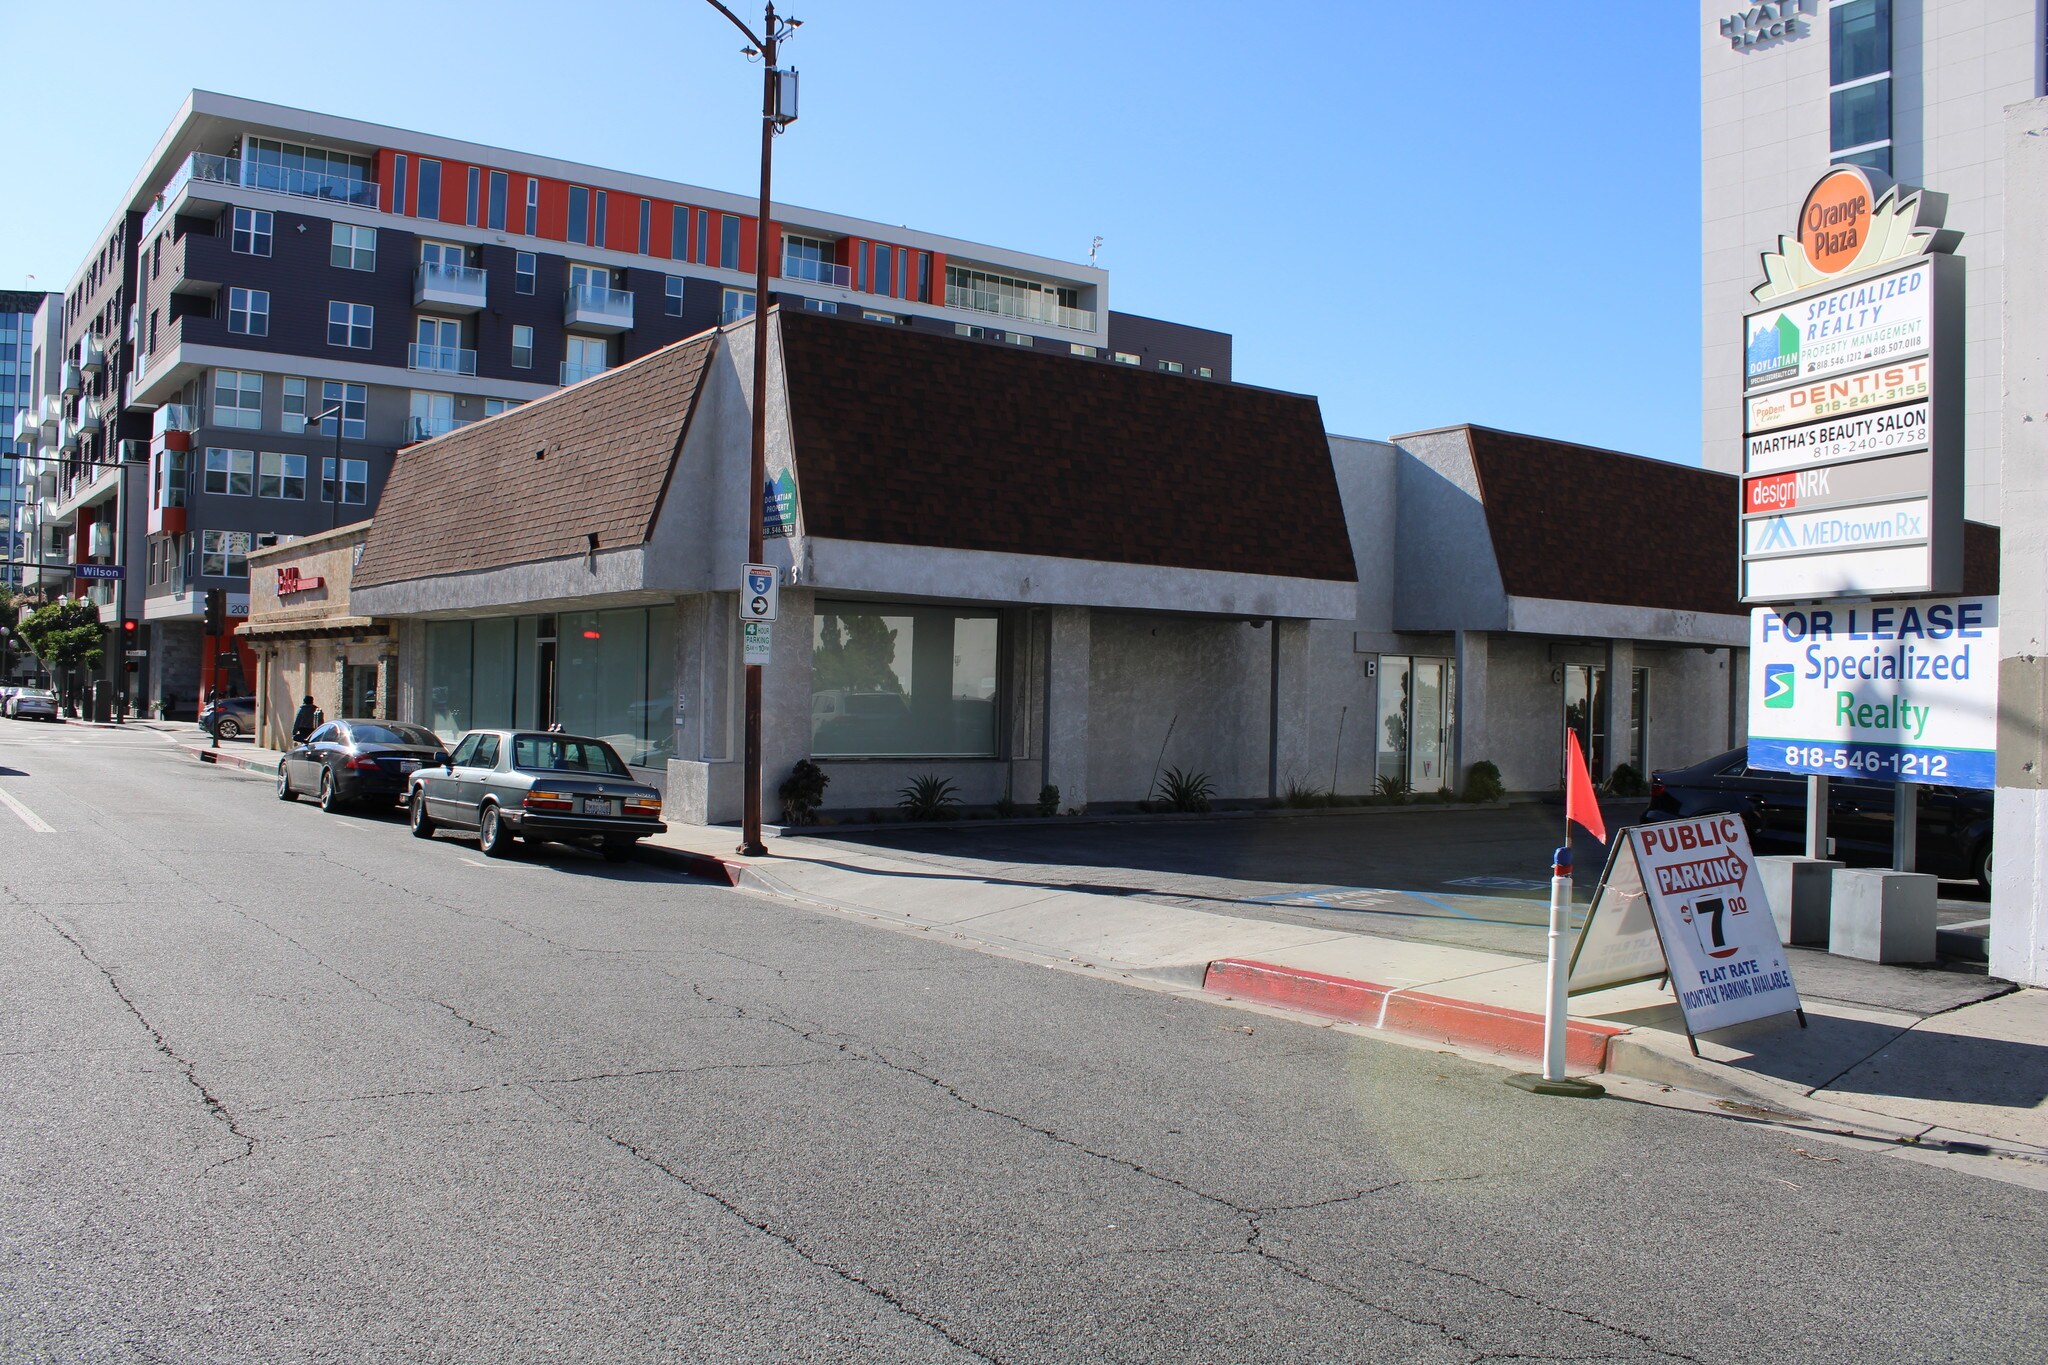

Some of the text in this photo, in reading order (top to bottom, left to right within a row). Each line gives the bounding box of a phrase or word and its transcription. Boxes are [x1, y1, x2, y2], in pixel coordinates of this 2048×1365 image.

[1731, 18, 1797, 49] PLACE
[1807, 195, 1866, 232] Orange
[1815, 228, 1858, 260] Plaza
[1807, 272, 1922, 321] SPECIALIZED
[1806, 304, 1883, 341] REALTY
[1802, 319, 1922, 360] PROPERTY MANAGEMENT
[1816, 335, 1922, 370] 818.546.1212 818.507.0118
[1790, 362, 1927, 409] DENTIST
[1814, 382, 1927, 415] 818-241-3155
[1756, 404, 1786, 417] ProDent
[1751, 409, 1927, 456] MARTHA'S BEAUTY SALON
[1813, 428, 1926, 458] 818-240-0758
[763, 512, 792, 522] MANAGEMENT
[766, 503, 790, 513] PROPERTY
[83, 566, 119, 577] Wilson
[756, 577, 765, 592] 5
[231, 604, 249, 614] 200
[1762, 603, 1984, 643] FOR LEASE
[746, 624, 769, 635] 4 HOUR
[746, 636, 770, 645] PARKING
[1365, 661, 1376, 678] B
[1804, 643, 1970, 689] Specialized
[1836, 691, 1930, 740] Realty
[1784, 745, 1948, 777] 818-546-1212
[1640, 818, 1740, 856] PUBLIC
[1657, 856, 1743, 894] PARKING
[1695, 897, 1725, 948] 7
[1728, 896, 1748, 913] 00
[1699, 959, 1760, 985] FLAT RATE
[1683, 970, 1791, 1011] MONTHLY PARKING AVAILABLE
